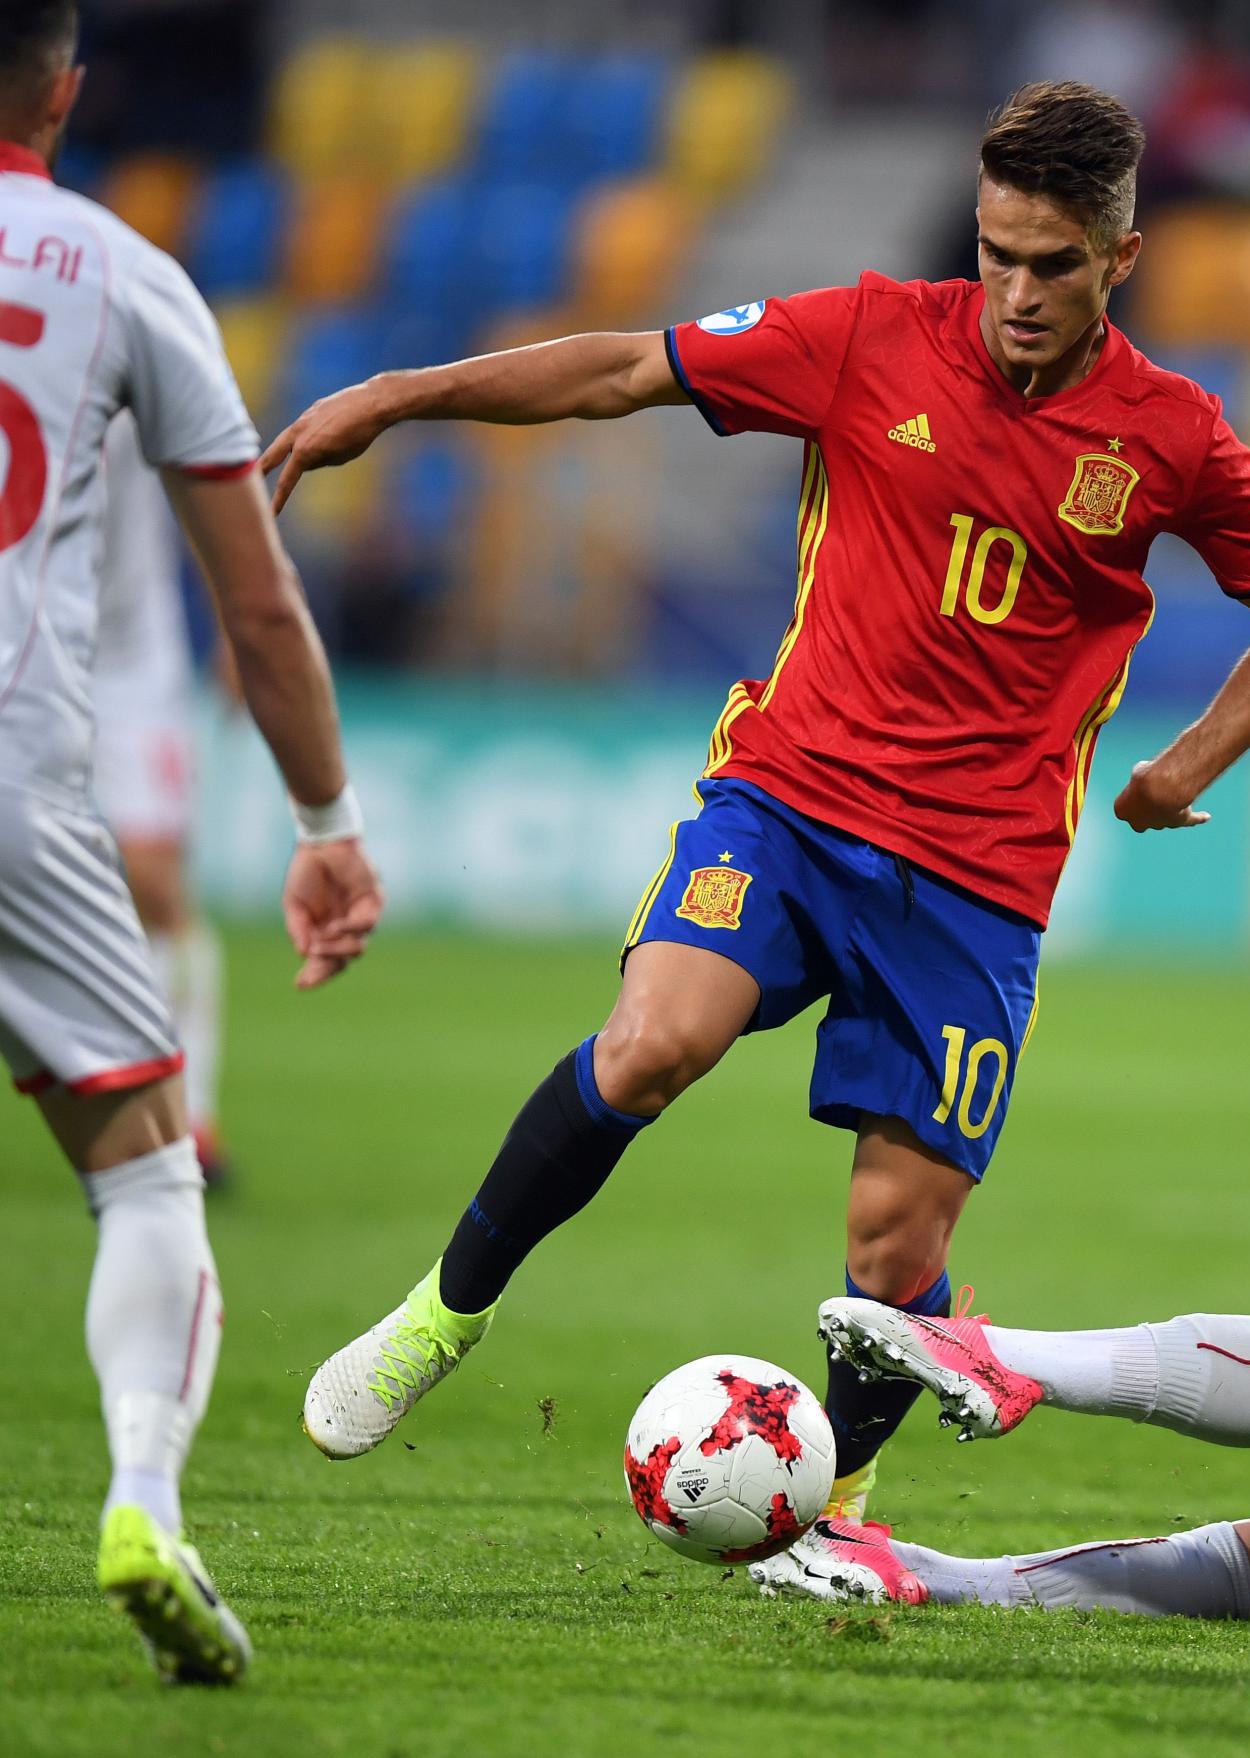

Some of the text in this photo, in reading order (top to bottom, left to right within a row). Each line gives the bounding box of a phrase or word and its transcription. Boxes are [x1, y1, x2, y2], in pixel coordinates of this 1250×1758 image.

[888, 429, 936, 453] adidas
[940, 513, 1027, 624] 10
[932, 1025, 1008, 1138] 10
[676, 1477, 709, 1489] adidas
